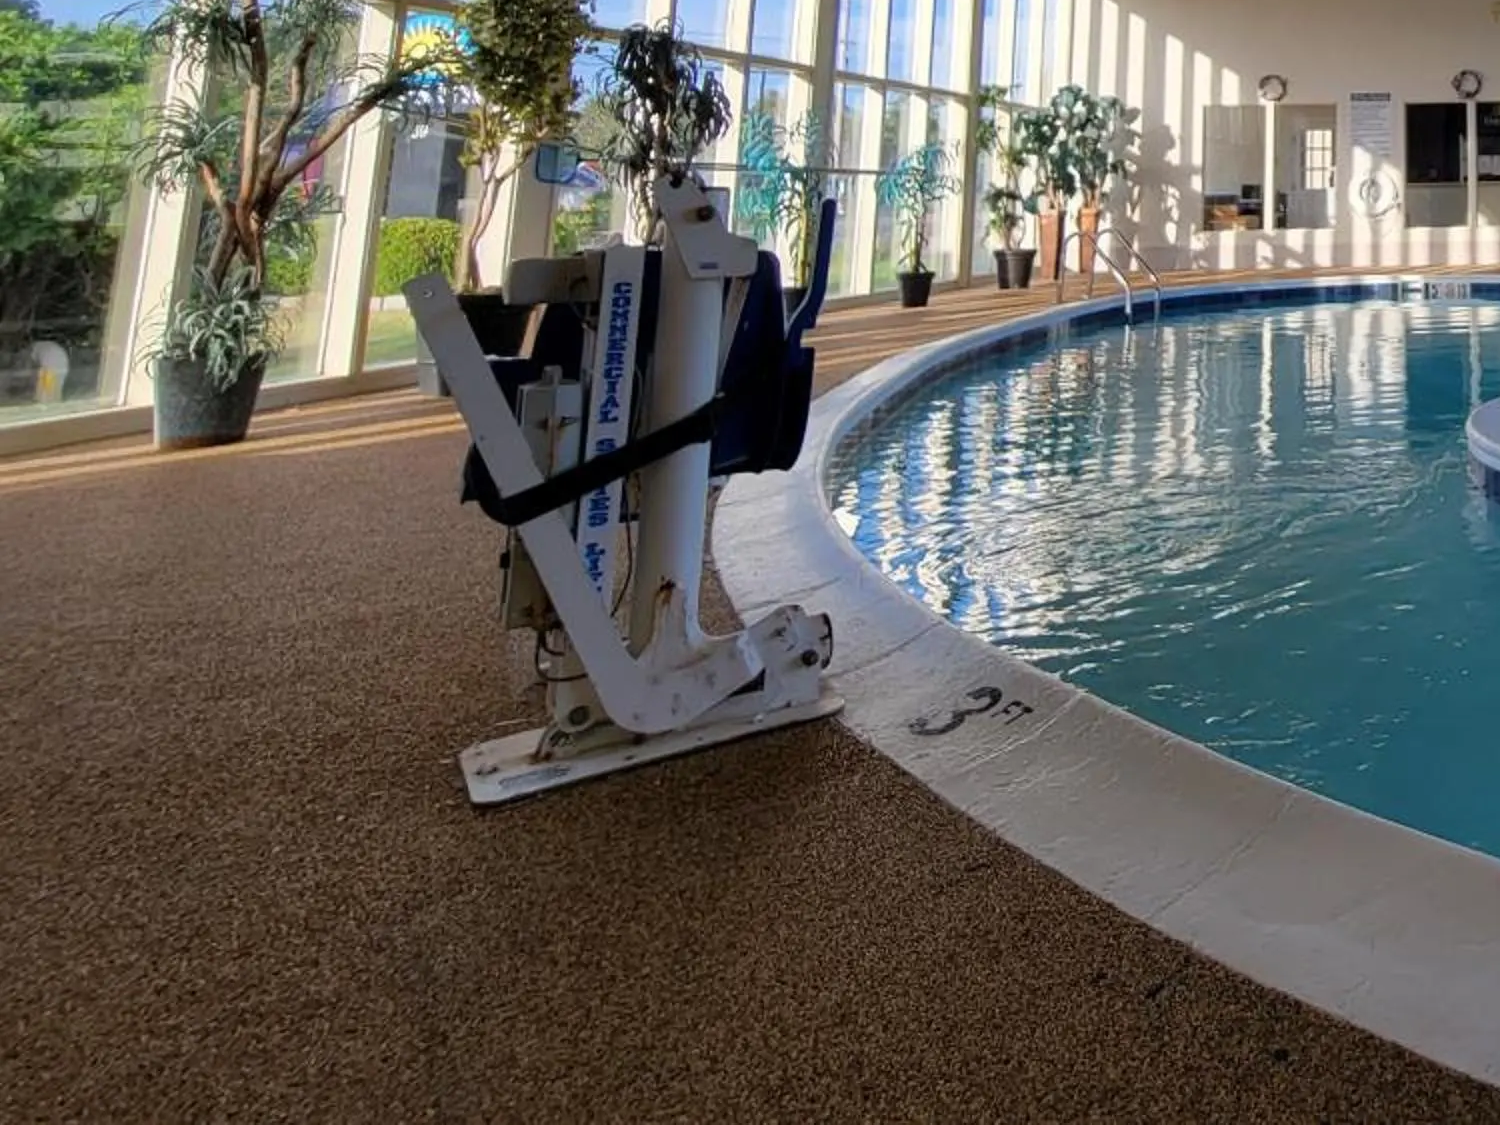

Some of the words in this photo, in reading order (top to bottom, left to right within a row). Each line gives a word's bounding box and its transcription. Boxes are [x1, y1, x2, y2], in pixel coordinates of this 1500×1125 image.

[597, 282, 633, 424] COMMERCIAL
[908, 686, 1002, 735] 3
[991, 700, 1034, 725] FT
